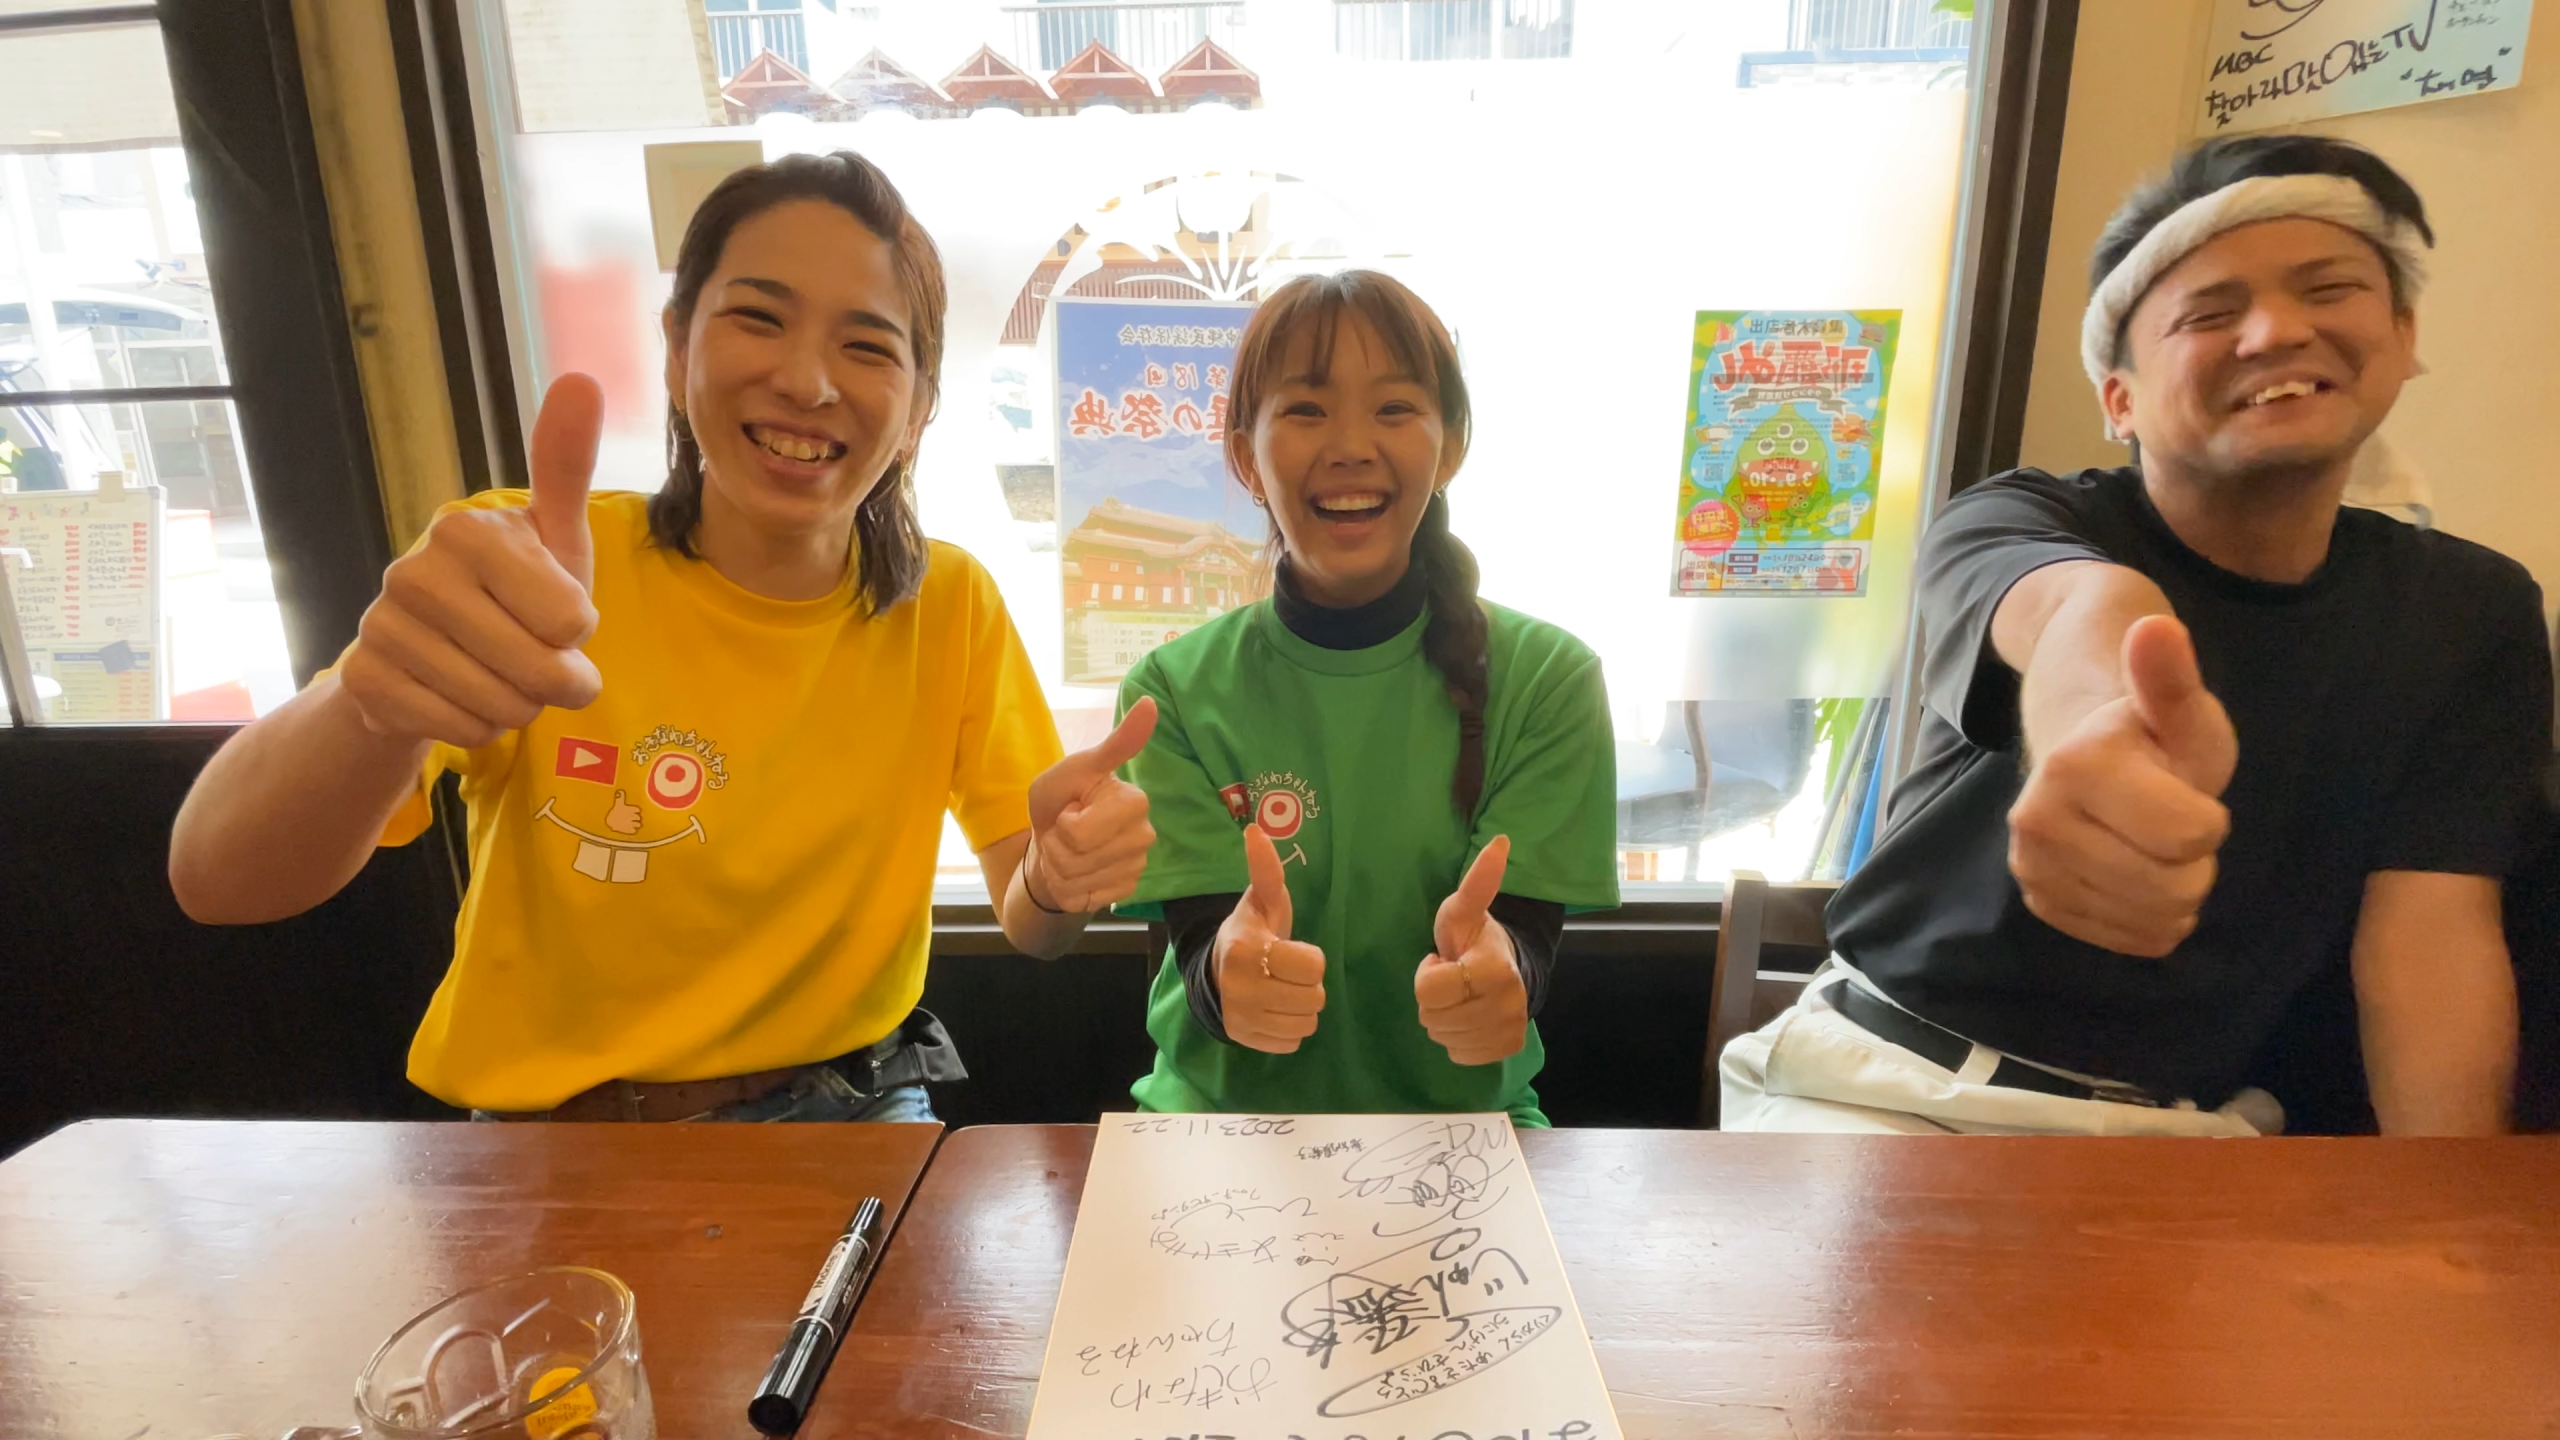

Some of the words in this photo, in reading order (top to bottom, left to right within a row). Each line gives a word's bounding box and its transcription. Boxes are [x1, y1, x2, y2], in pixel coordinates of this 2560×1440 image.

[2210, 43, 2275, 81] MBC
[632, 725, 729, 790] おきなわちゃんねる
[1074, 1319, 1236, 1375] ちゃんねる
[1111, 1358, 1277, 1412] おきなわ
